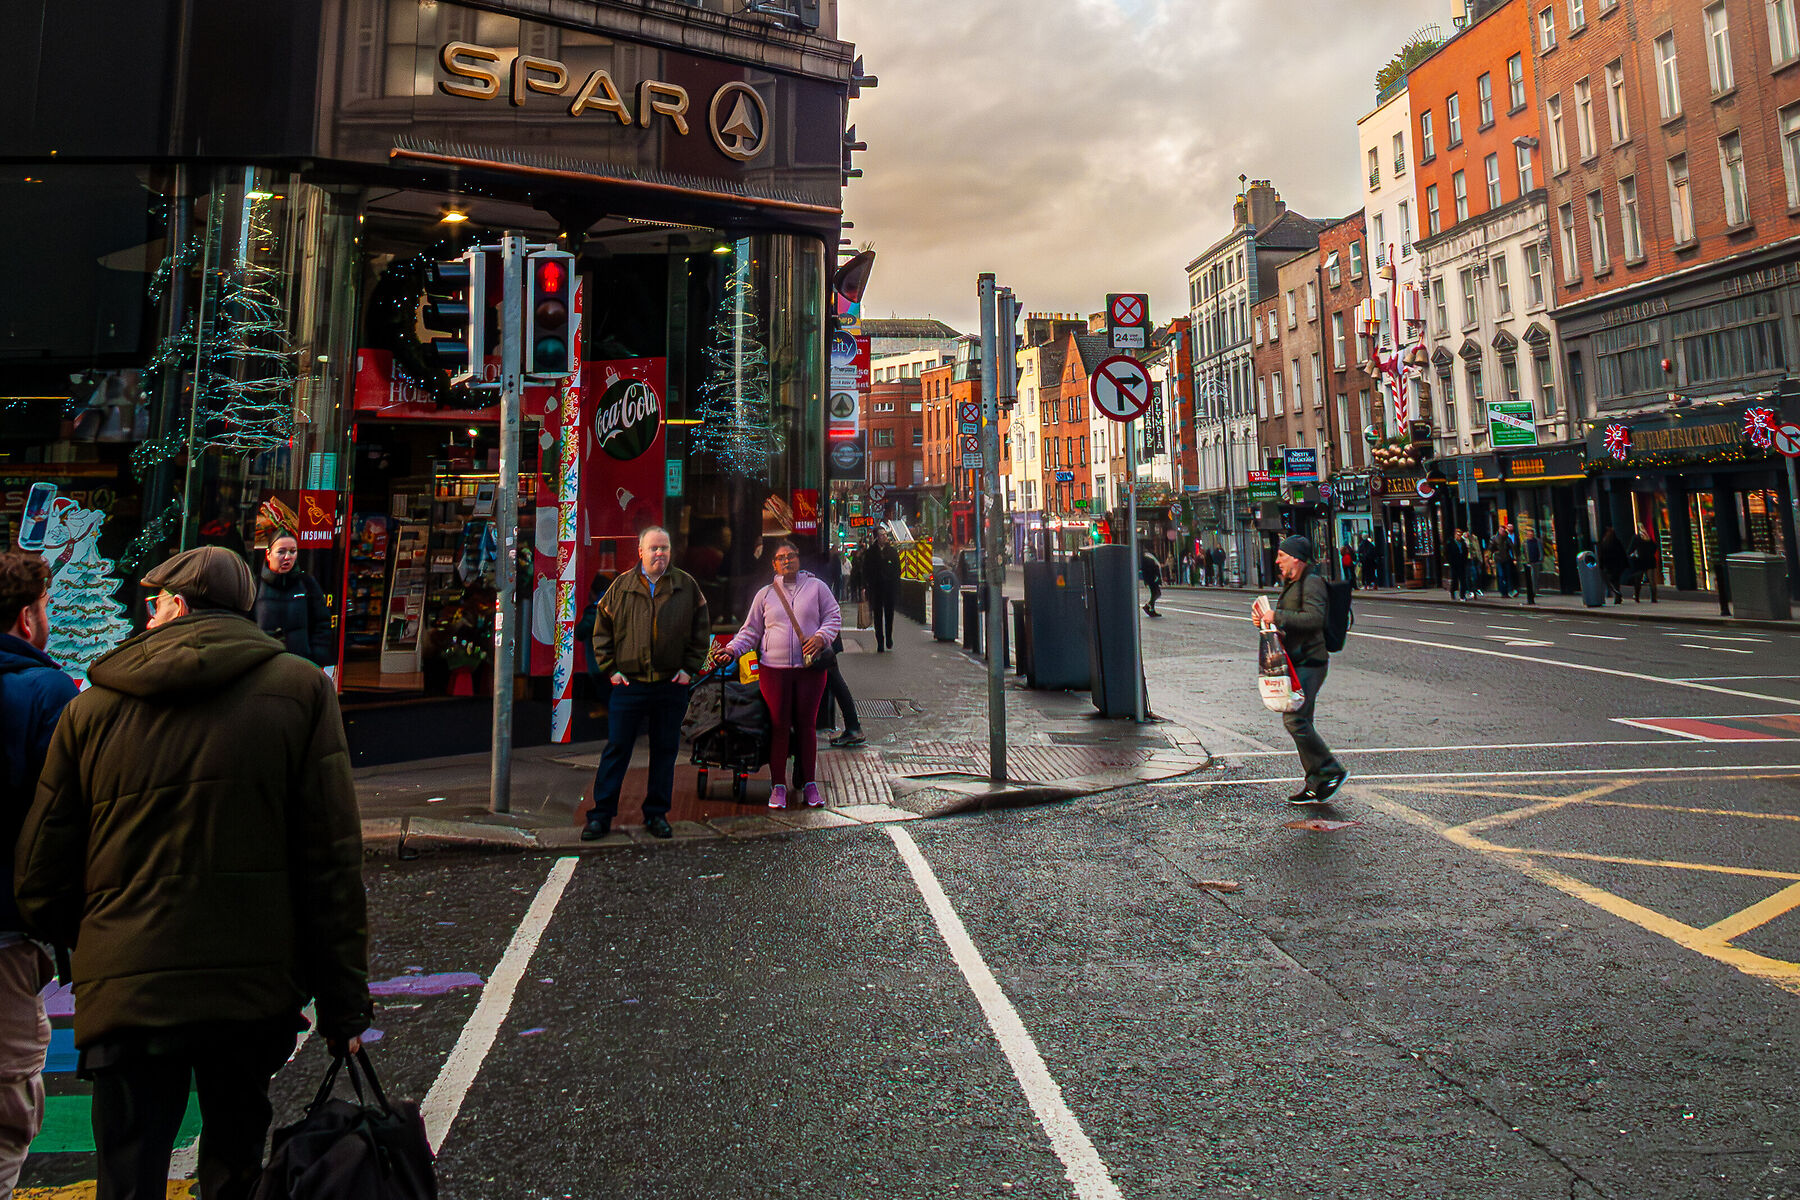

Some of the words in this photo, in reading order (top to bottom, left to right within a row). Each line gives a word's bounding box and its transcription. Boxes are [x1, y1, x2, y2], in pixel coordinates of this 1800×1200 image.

[439, 41, 690, 137] SPAR
[1115, 333, 1128, 342] 24
[301, 530, 332, 541] INSOMNIA
